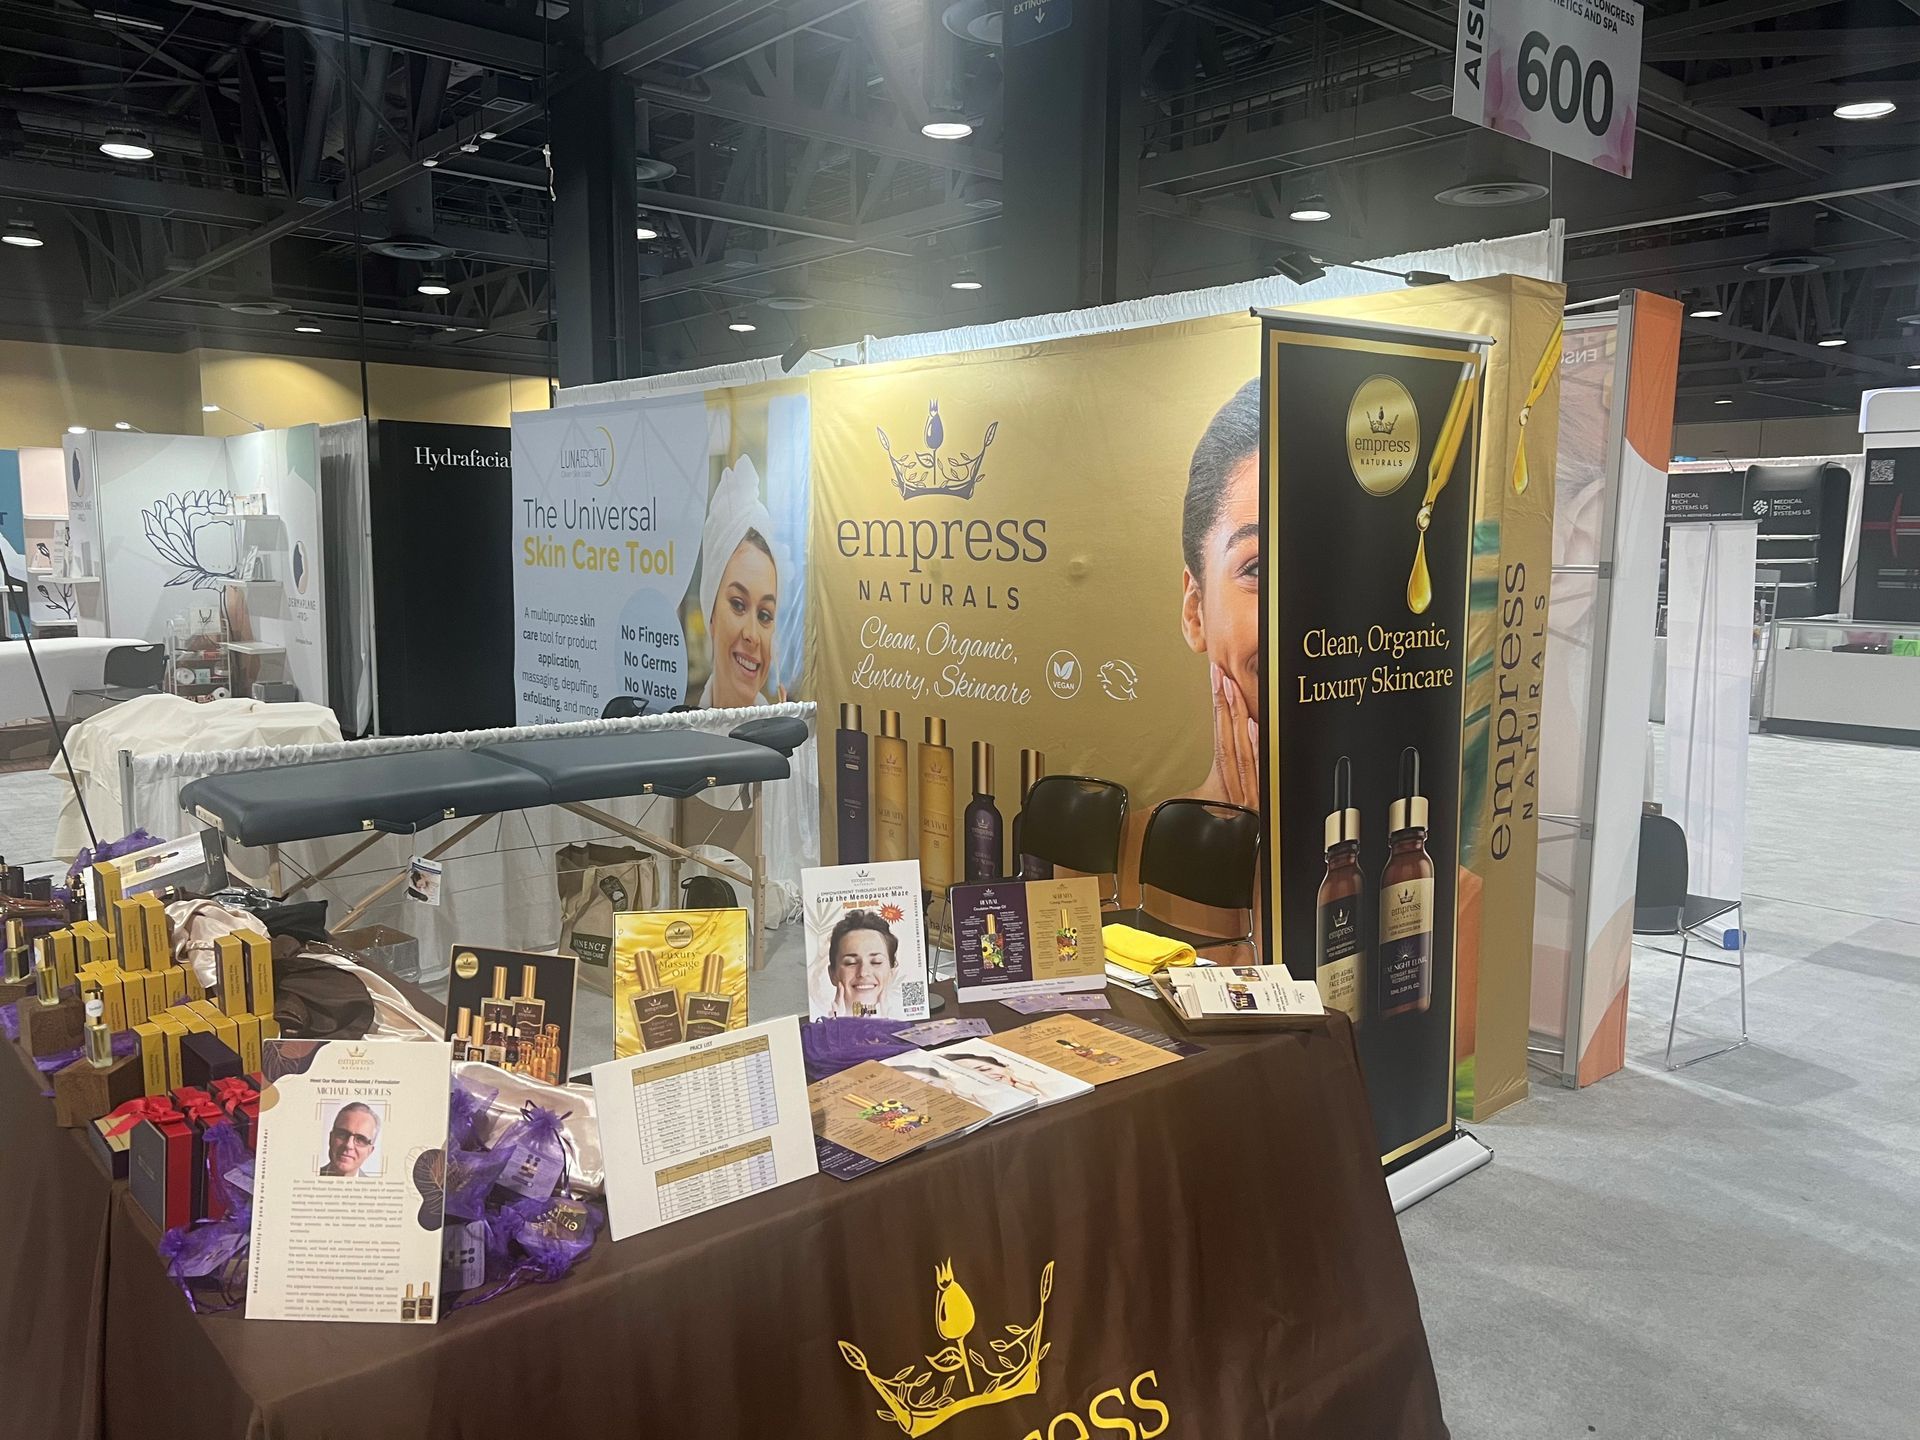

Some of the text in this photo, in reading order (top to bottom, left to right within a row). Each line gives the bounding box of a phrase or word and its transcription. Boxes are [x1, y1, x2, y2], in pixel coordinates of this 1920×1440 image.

[1584, 8, 1602, 25] AND
[1603, 17, 1618, 35] SPA
[1517, 30, 1614, 137] 600
[415, 446, 512, 471] Hydrafacial
[1354, 437, 1411, 456] empress
[1360, 458, 1403, 467] NATURALS
[523, 497, 657, 532] The Universal
[523, 535, 675, 577] Skin Care Tool
[837, 516, 1048, 574] empress
[858, 580, 1021, 611] NATURALS
[531, 607, 579, 626] multipurpose
[579, 615, 596, 628] skin
[523, 629, 598, 651] care tool for product
[621, 624, 680, 648] No Fingers
[860, 615, 1019, 666] Clean, Organic,
[1303, 621, 1450, 660] Clean, Organic,
[538, 652, 582, 673] application,
[624, 650, 677, 674] No Germs
[624, 676, 677, 700] No Waste
[851, 653, 1032, 706] Luxury, Skincare
[1053, 681, 1075, 691] VEGAN
[1298, 664, 1454, 706] Luxury Skincare
[563, 700, 578, 714] and
[579, 704, 599, 718] more
[1491, 561, 1526, 861] empress
[1522, 594, 1547, 820] NATURALS
[816, 896, 834, 904] Grab
[849, 891, 889, 901] Menopause
[1392, 902, 1422, 917] empress
[931, 919, 953, 935] hash
[659, 961, 700, 971] Massage
[672, 969, 687, 977] Oil
[689, 1043, 704, 1051] PRICE
[316, 1087, 350, 1096] MICHAEL
